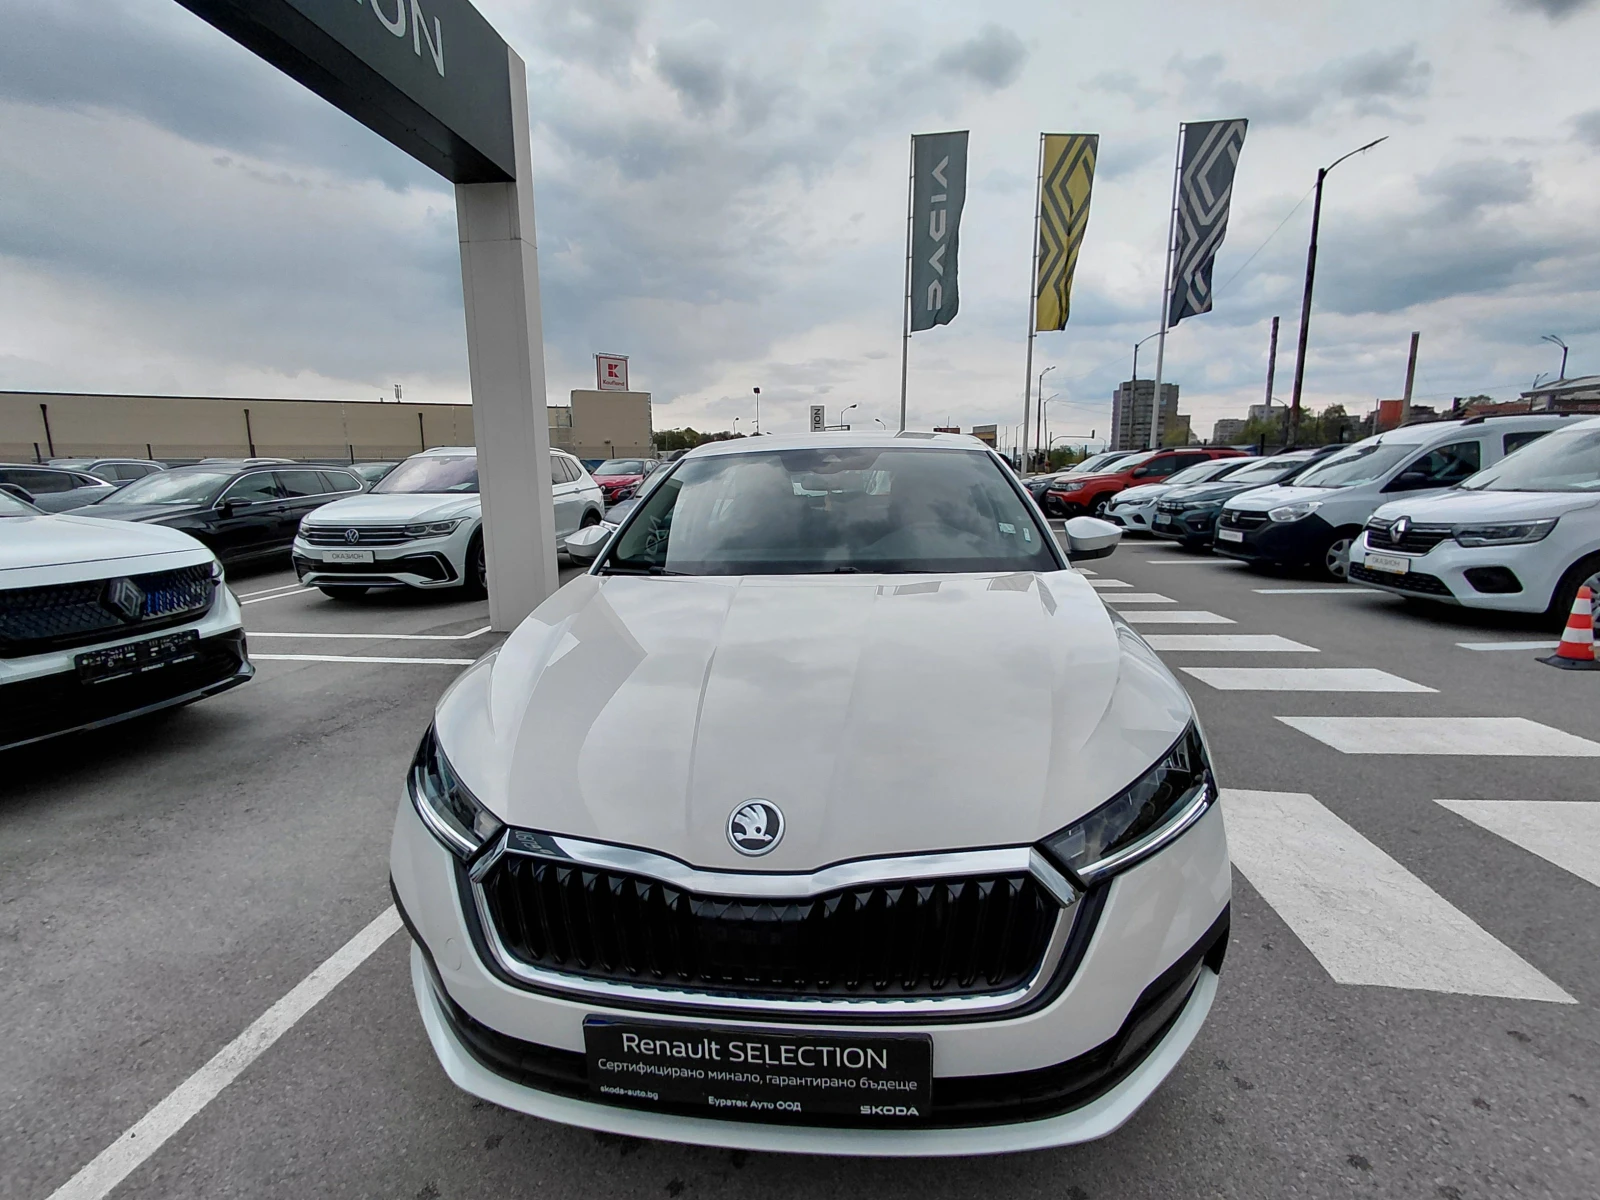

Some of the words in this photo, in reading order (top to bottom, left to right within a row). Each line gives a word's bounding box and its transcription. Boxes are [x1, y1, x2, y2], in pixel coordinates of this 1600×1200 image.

[357, 0, 445, 78] ON
[926, 155, 949, 311] DACIA
[602, 379, 625, 387] Kaufland
[331, 552, 364, 560] ОКАЗИОН
[621, 1032, 721, 1061] Renault
[728, 1041, 887, 1069] SELECTION
[598, 1058, 705, 1079] Сертифицирано
[708, 1070, 763, 1085] минало,
[766, 1075, 856, 1089] гарантирано
[859, 1077, 918, 1091] бъдеще
[600, 1085, 659, 1101] skoda-auto.bg
[708, 1096, 748, 1108] Еуратек
[750, 1099, 775, 1110] Ауто
[776, 1101, 802, 1112] ООД
